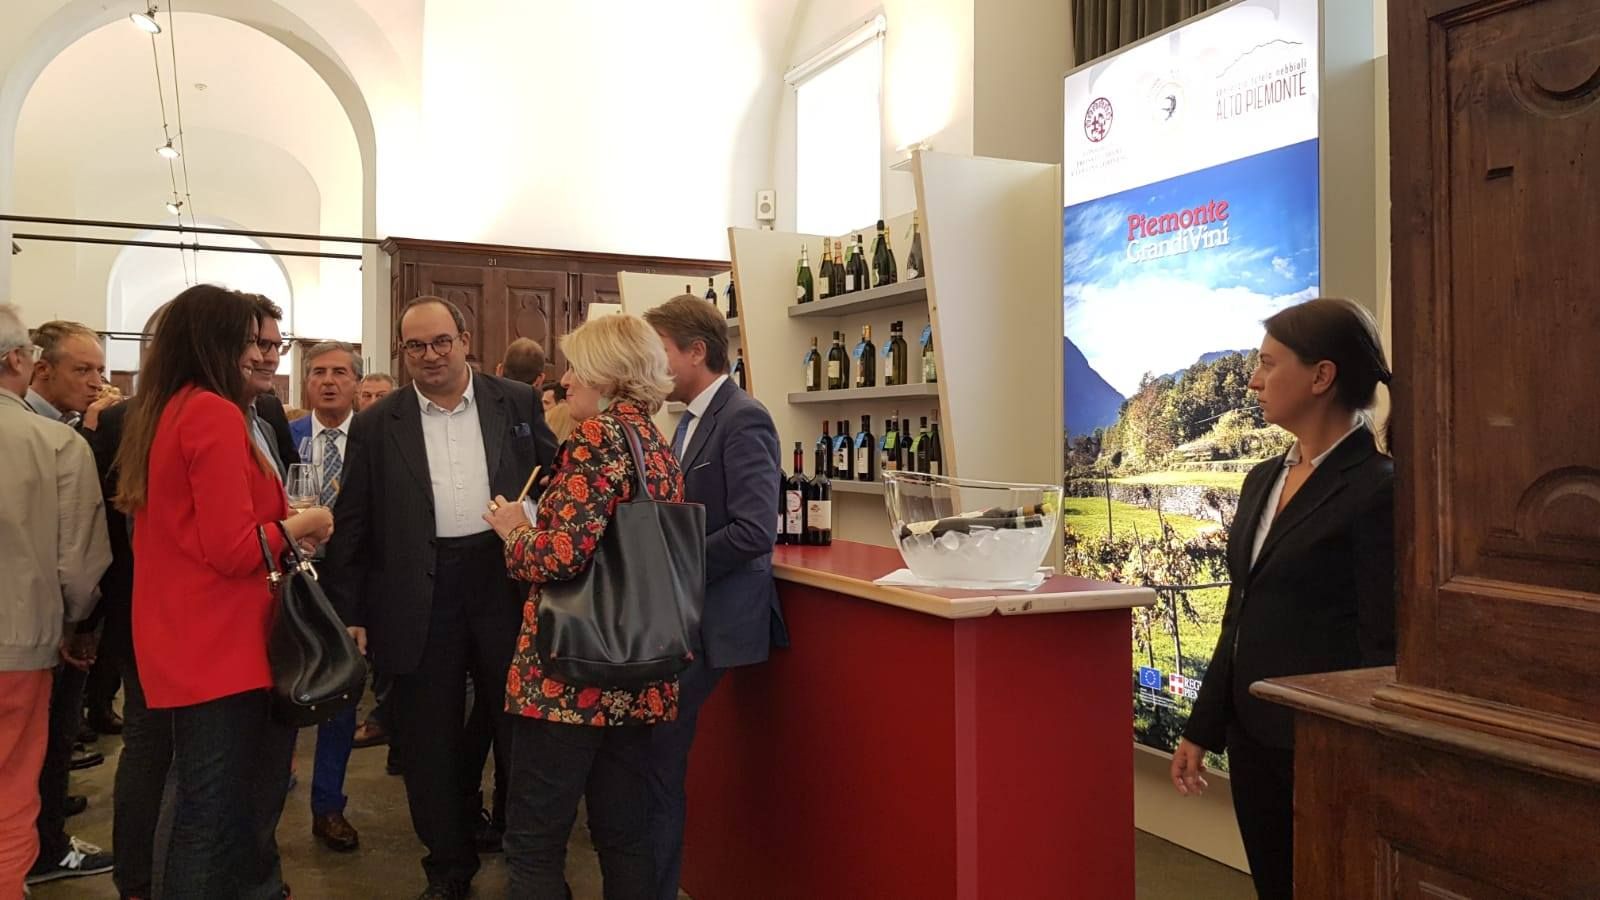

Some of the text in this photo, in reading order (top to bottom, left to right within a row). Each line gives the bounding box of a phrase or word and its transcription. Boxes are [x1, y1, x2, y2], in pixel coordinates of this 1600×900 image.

[1216, 92, 1242, 120] ALTO
[1245, 71, 1307, 113] PIEMONTE
[1127, 199, 1229, 241] Piemonte
[488, 258, 497, 266] 21
[1126, 220, 1230, 264] GrandiVini
